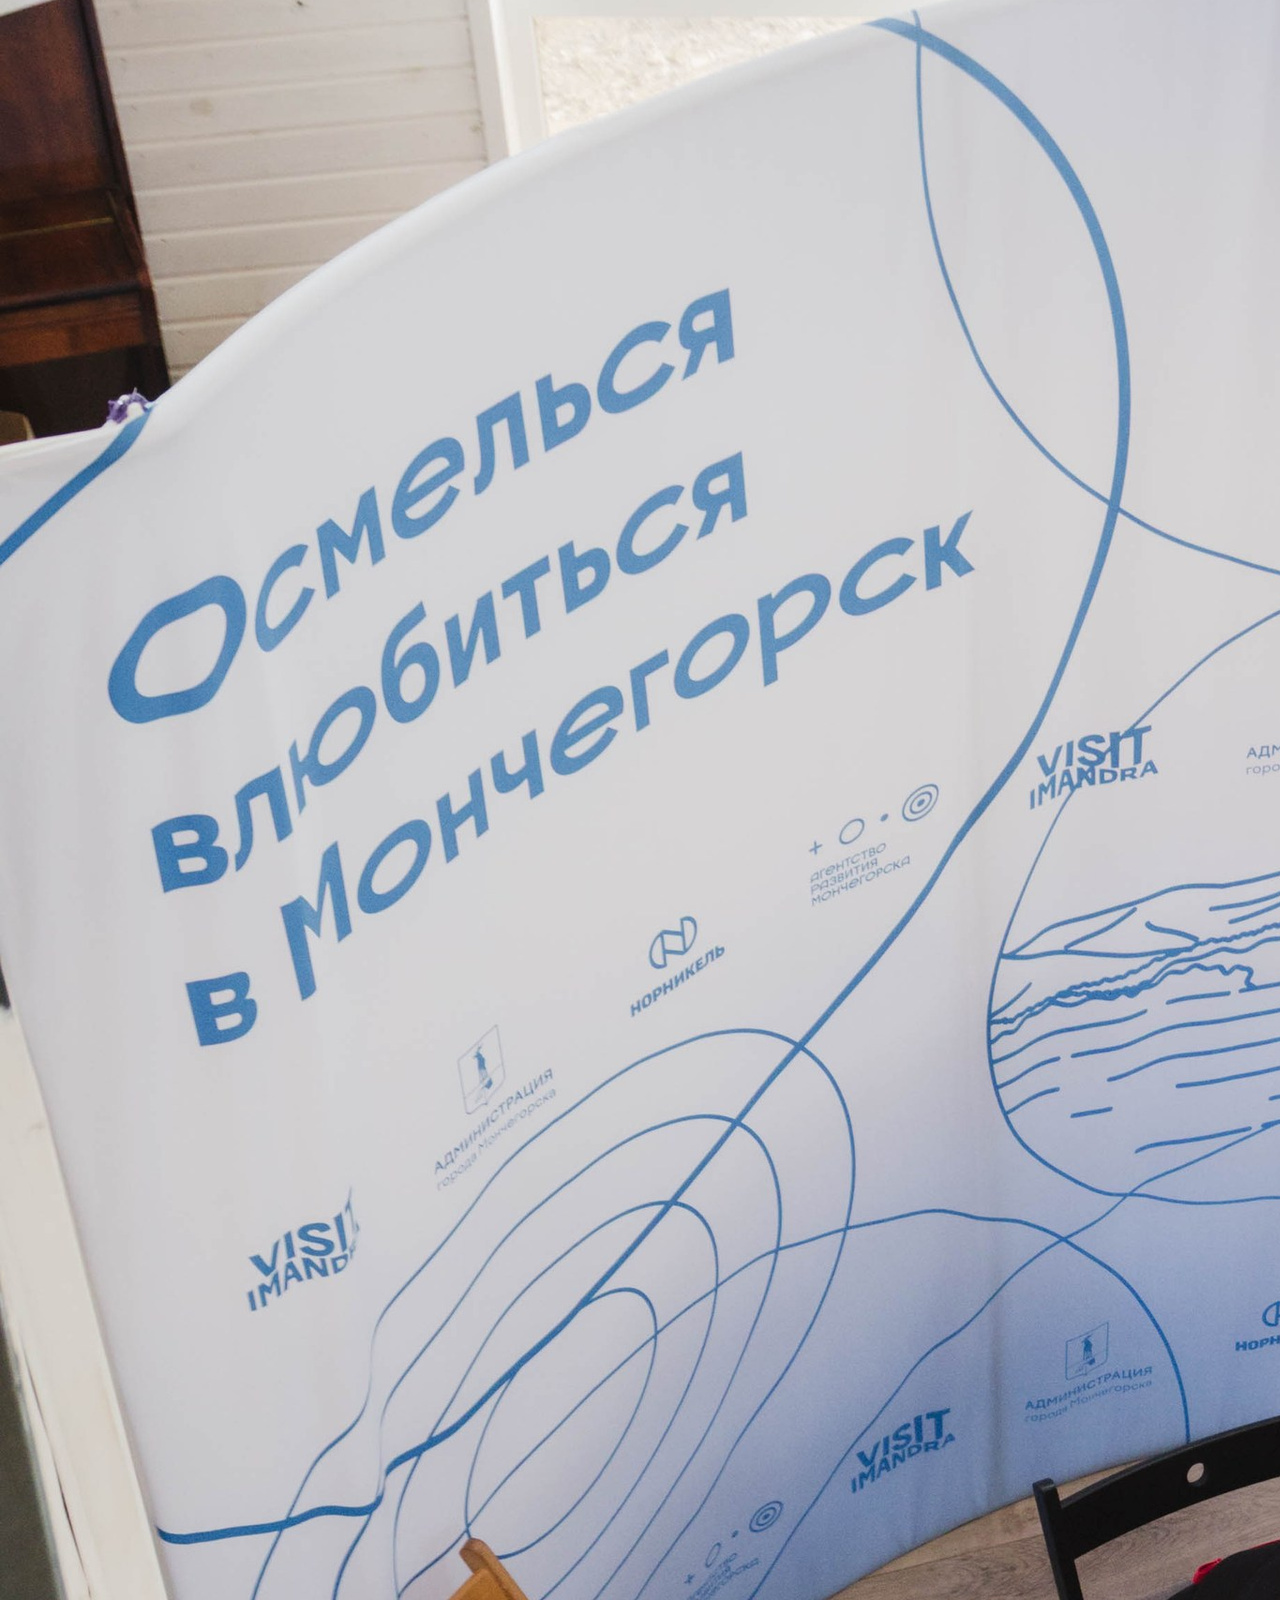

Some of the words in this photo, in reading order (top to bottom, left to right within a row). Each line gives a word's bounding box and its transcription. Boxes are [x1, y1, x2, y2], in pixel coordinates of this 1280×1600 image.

[108, 288, 737, 724] Осмелься
[150, 451, 749, 893] влюбиться
[186, 971, 258, 1047] в
[280, 510, 975, 1001] Мончегорск
[1037, 725, 1152, 777] VISIT
[1030, 760, 1159, 810] IMANDRA
[630, 946, 725, 1017] НОРНИКЕЛЬ
[434, 1068, 554, 1174] АДМИНИСТРАЦИЯ
[1025, 1366, 1152, 1410] АДМИНИСТРАЦИЯ
[851, 1433, 955, 1494] IMANDRA
[857, 1407, 951, 1467] VISIT
